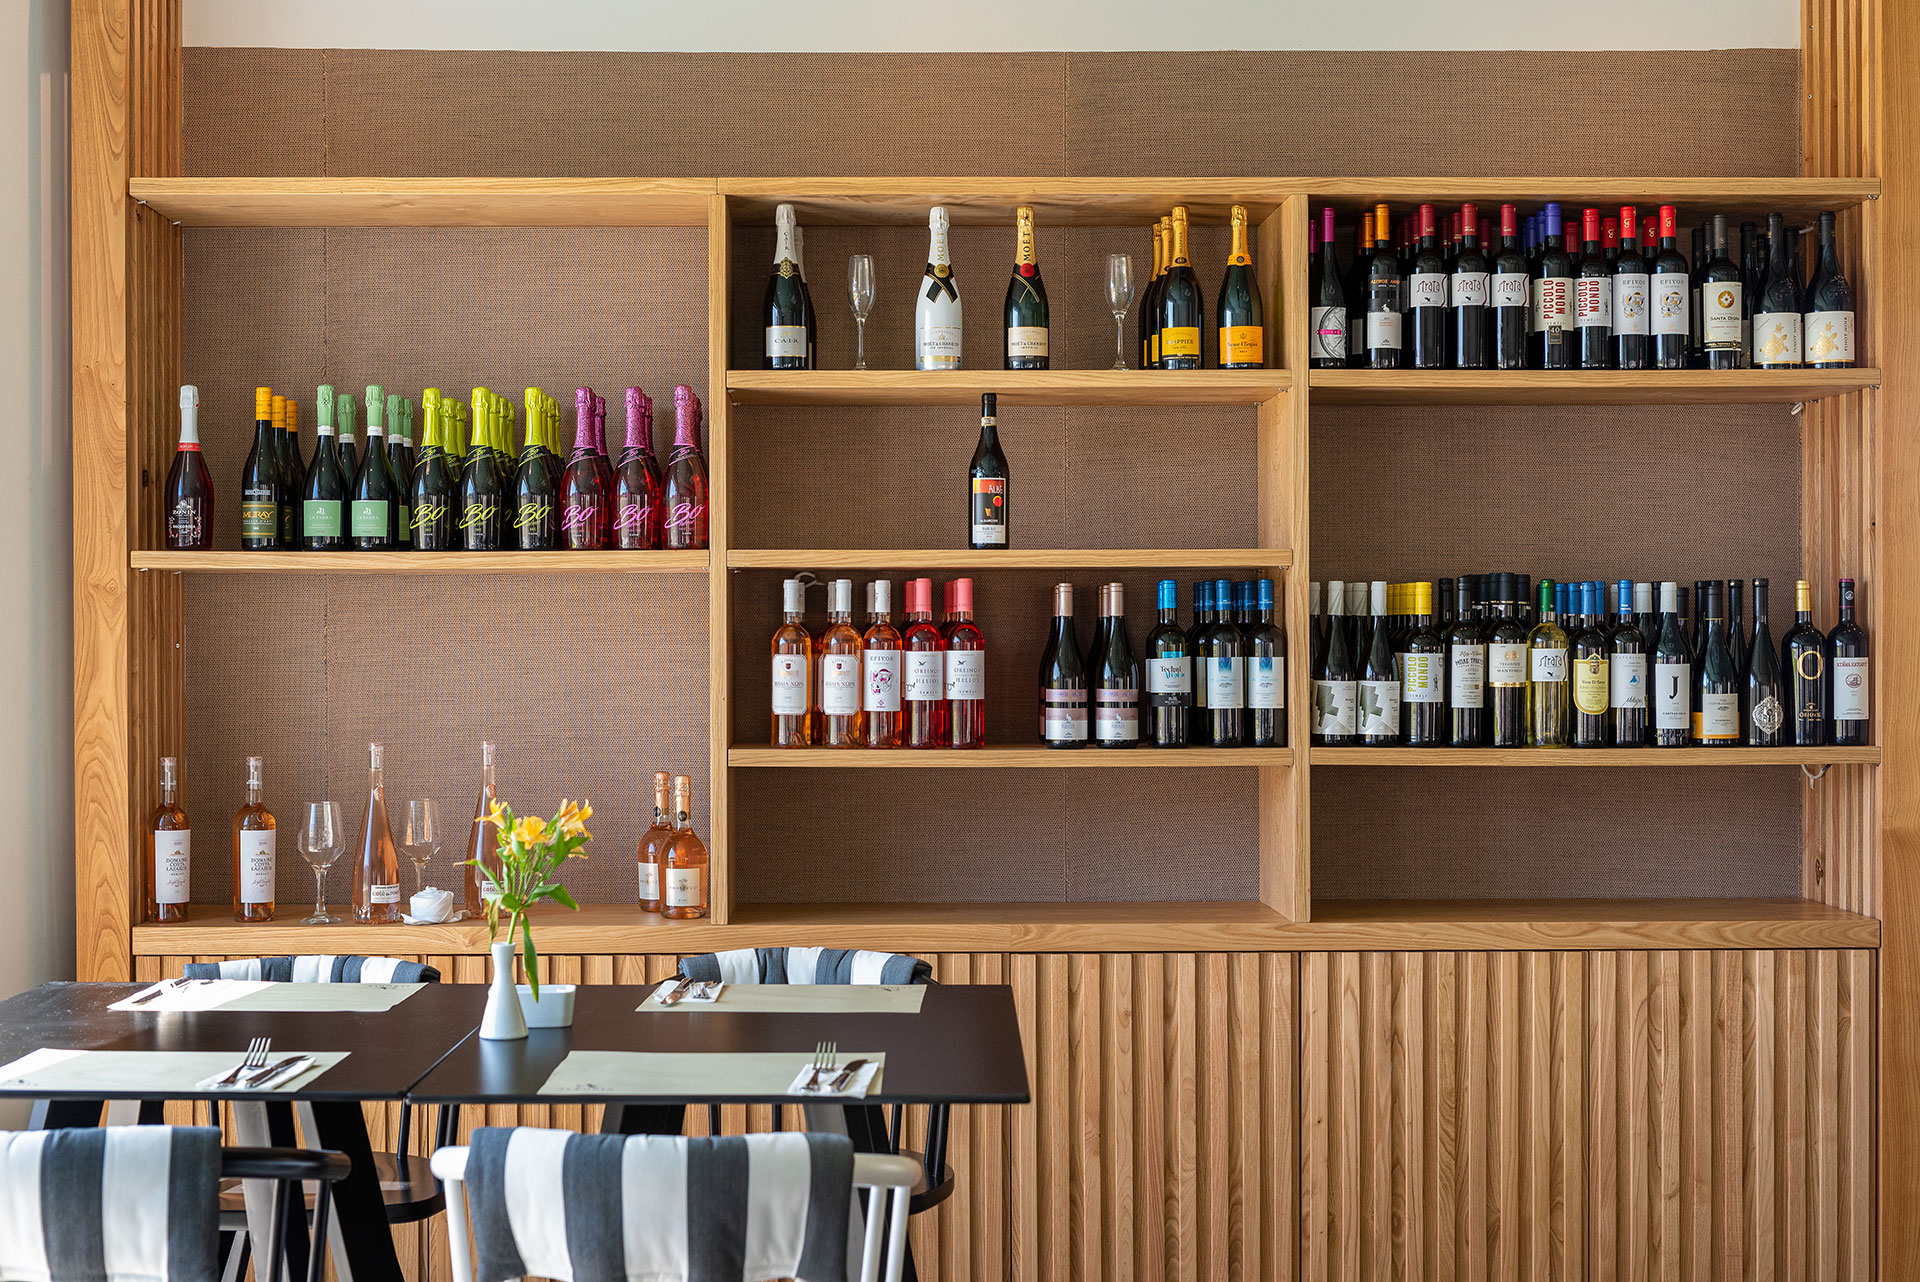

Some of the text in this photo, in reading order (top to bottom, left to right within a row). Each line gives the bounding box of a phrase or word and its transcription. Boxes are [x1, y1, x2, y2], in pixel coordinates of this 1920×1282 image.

[1543, 279, 1554, 320] PICCOLO
[1555, 281, 1566, 315] MONDO
[1578, 281, 1588, 317] PICCOLO
[1589, 280, 1600, 313] MONDO
[1550, 326, 1561, 334] 40
[988, 484, 1004, 494] ALBE
[243, 511, 274, 520] MURAY
[1407, 656, 1417, 692] PICCOLO
[1418, 656, 1429, 688] MONDO
[1669, 676, 1680, 699] J
